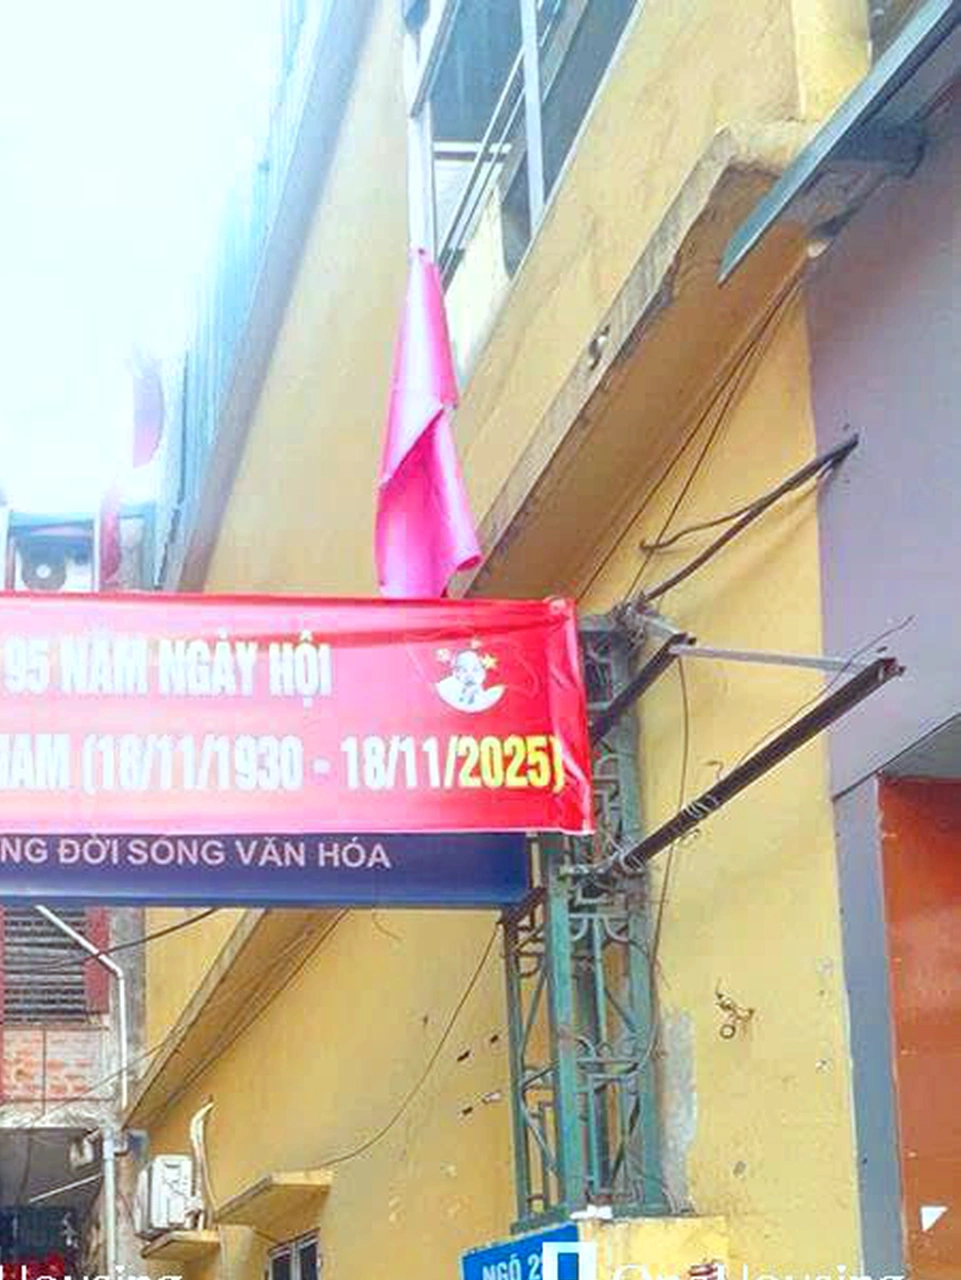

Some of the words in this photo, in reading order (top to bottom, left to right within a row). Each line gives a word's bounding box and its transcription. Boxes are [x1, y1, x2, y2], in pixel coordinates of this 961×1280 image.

[3, 633, 50, 694] 95
[269, 629, 332, 708] HỘI
[82, 733, 304, 795] (18/11/1930
[340, 734, 565, 795] 18/11/2025)
